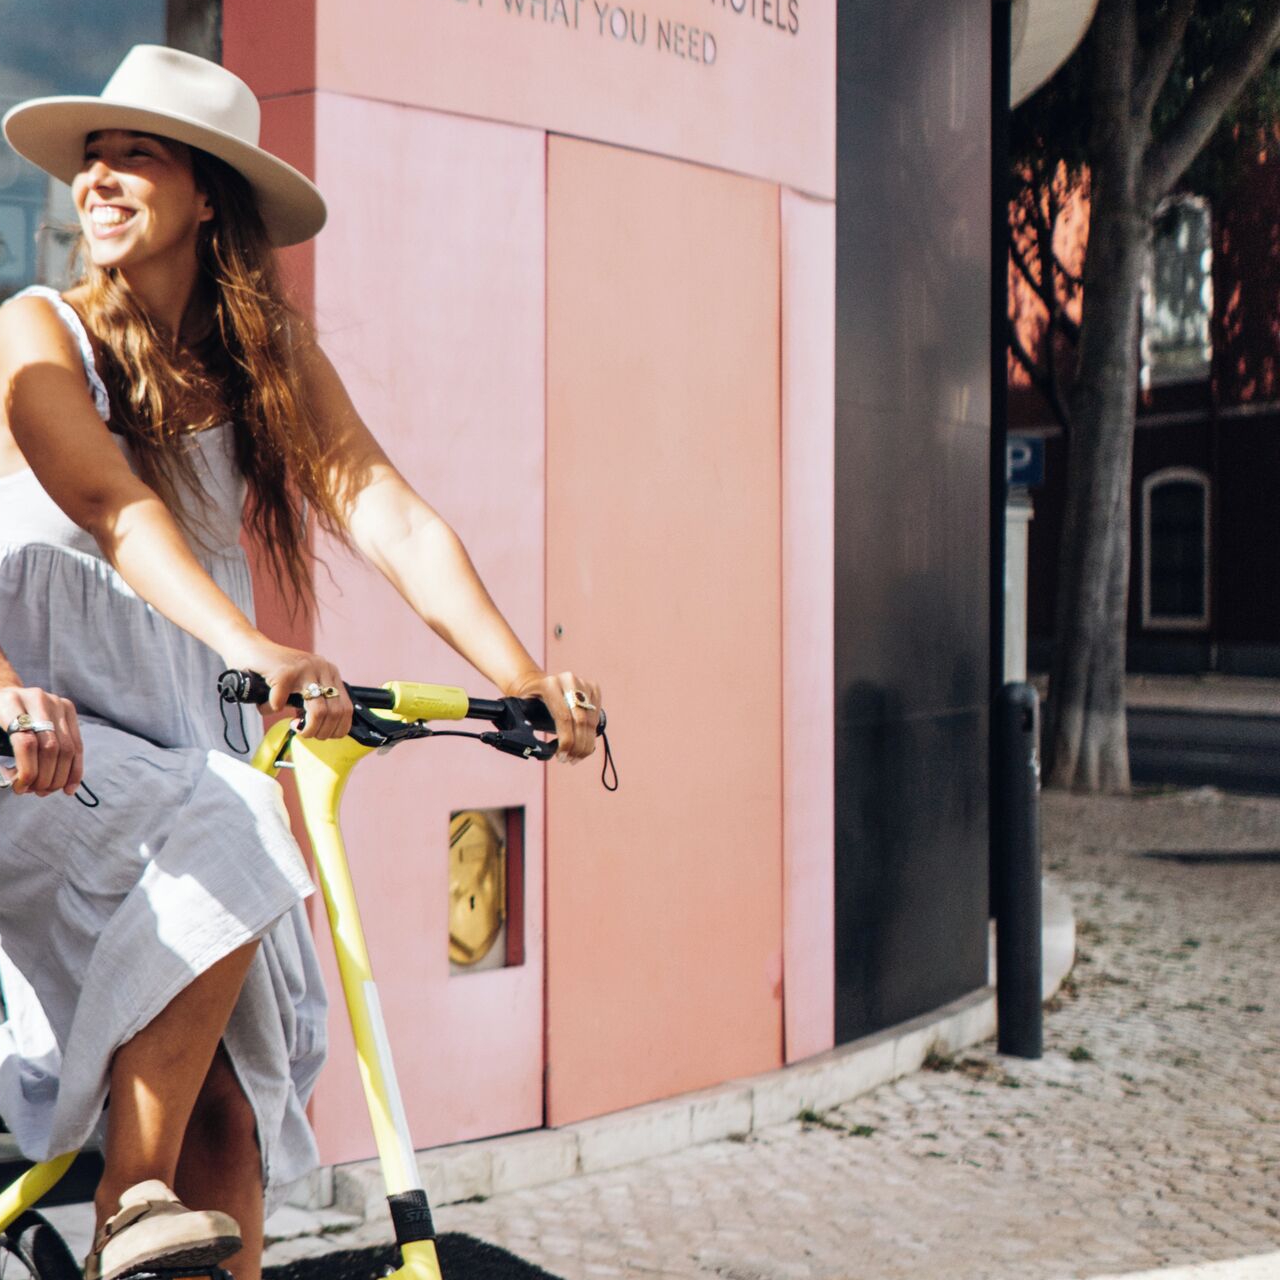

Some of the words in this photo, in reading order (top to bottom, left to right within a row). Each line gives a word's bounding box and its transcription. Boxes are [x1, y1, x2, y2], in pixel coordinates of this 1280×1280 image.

[594, 0, 647, 46] YOU
[658, 19, 717, 66] NEED
[1006, 442, 1032, 481] P
